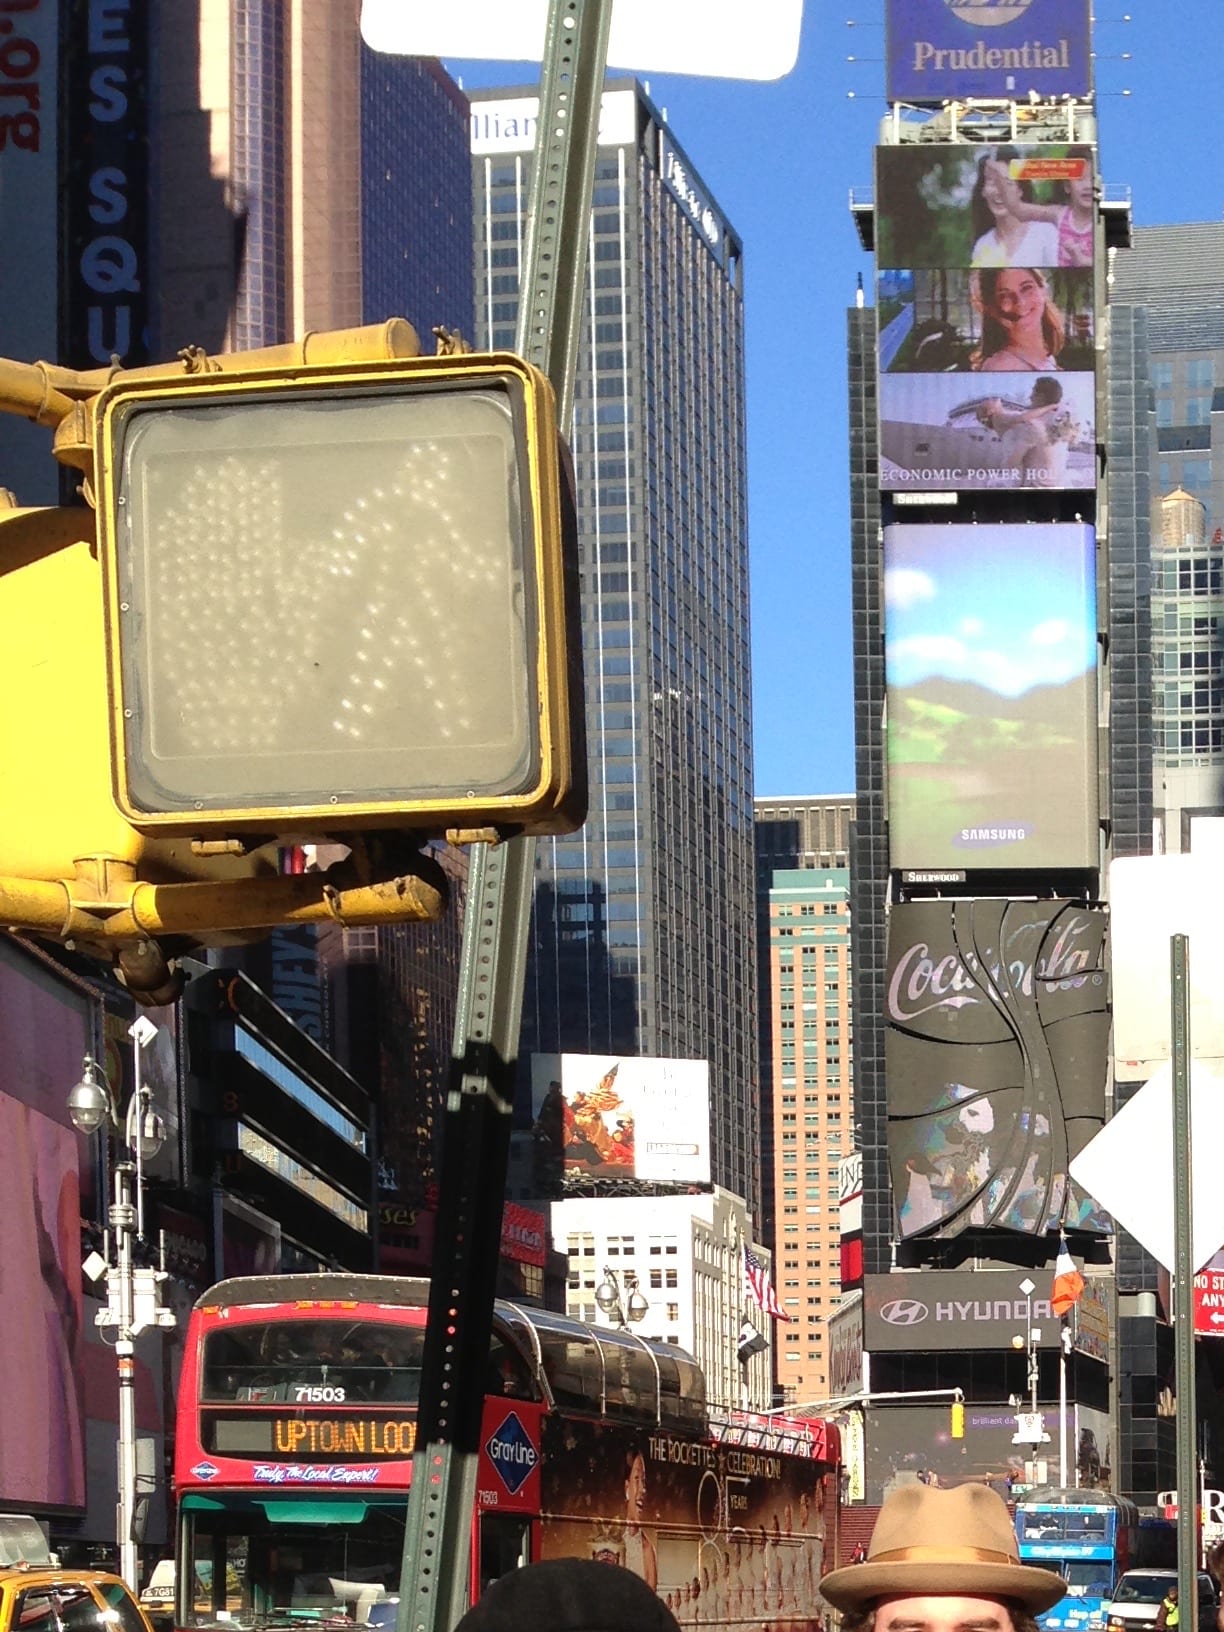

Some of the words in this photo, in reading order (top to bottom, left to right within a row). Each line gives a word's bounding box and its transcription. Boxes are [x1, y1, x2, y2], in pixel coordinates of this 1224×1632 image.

[913, 39, 1069, 71] Prudential
[0, 0, 40, 152] .org
[880, 468, 961, 480] ECONOMIC
[967, 468, 1021, 479] POWER
[961, 829, 1025, 840] SAMSUNG
[1194, 1275, 1208, 1289] NO
[295, 1387, 345, 1402] 71503
[277, 1420, 363, 1452] UPTOWN
[370, 1421, 417, 1453] LOO
[649, 1437, 667, 1461] THE
[668, 1441, 717, 1468] ROCKETTES
[727, 1451, 781, 1479] CELEBRATION!
[301, 1466, 334, 1480] Local
